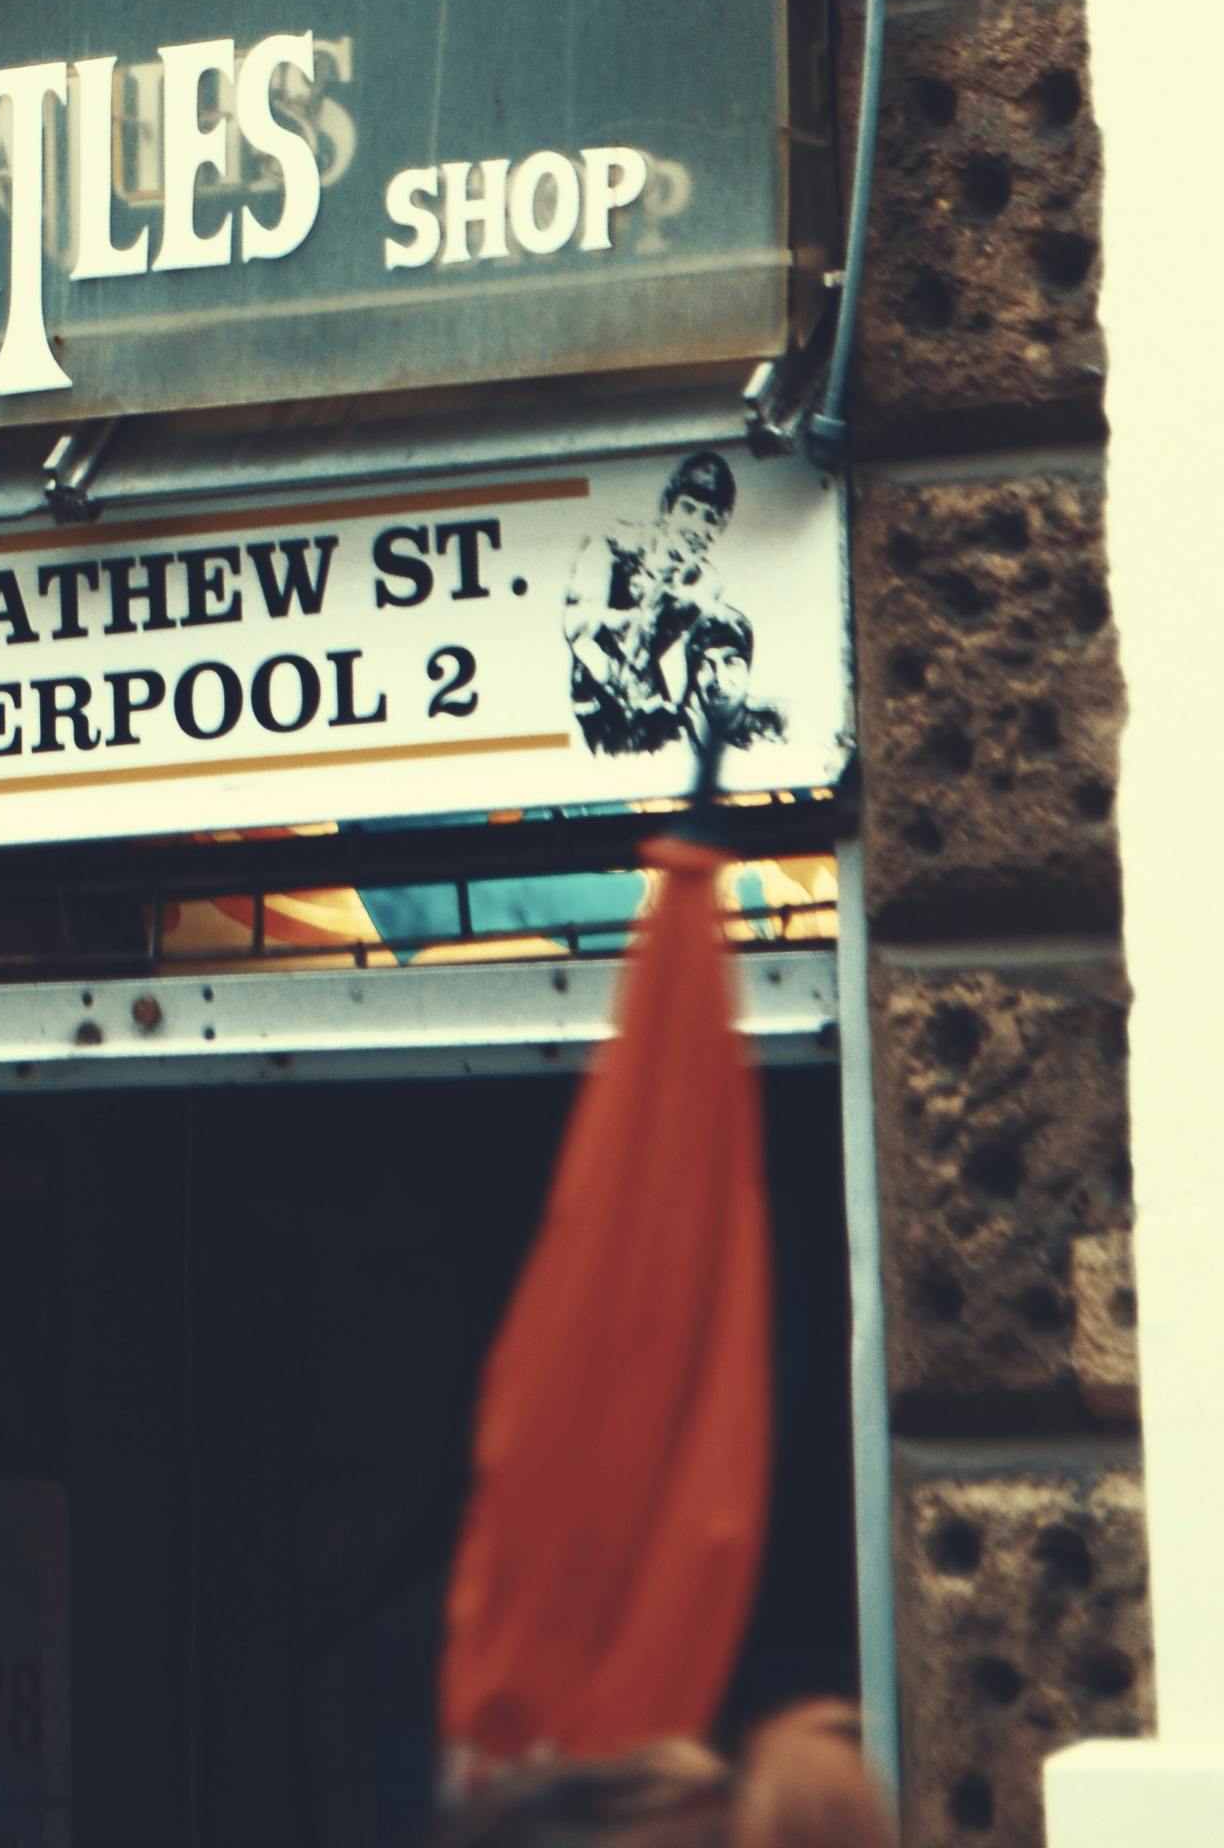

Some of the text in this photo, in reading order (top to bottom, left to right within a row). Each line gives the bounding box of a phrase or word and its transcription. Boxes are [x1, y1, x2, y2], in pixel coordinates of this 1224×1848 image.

[385, 146, 647, 271] SHOP
[372, 518, 529, 609] ST.
[426, 645, 479, 719] 2
